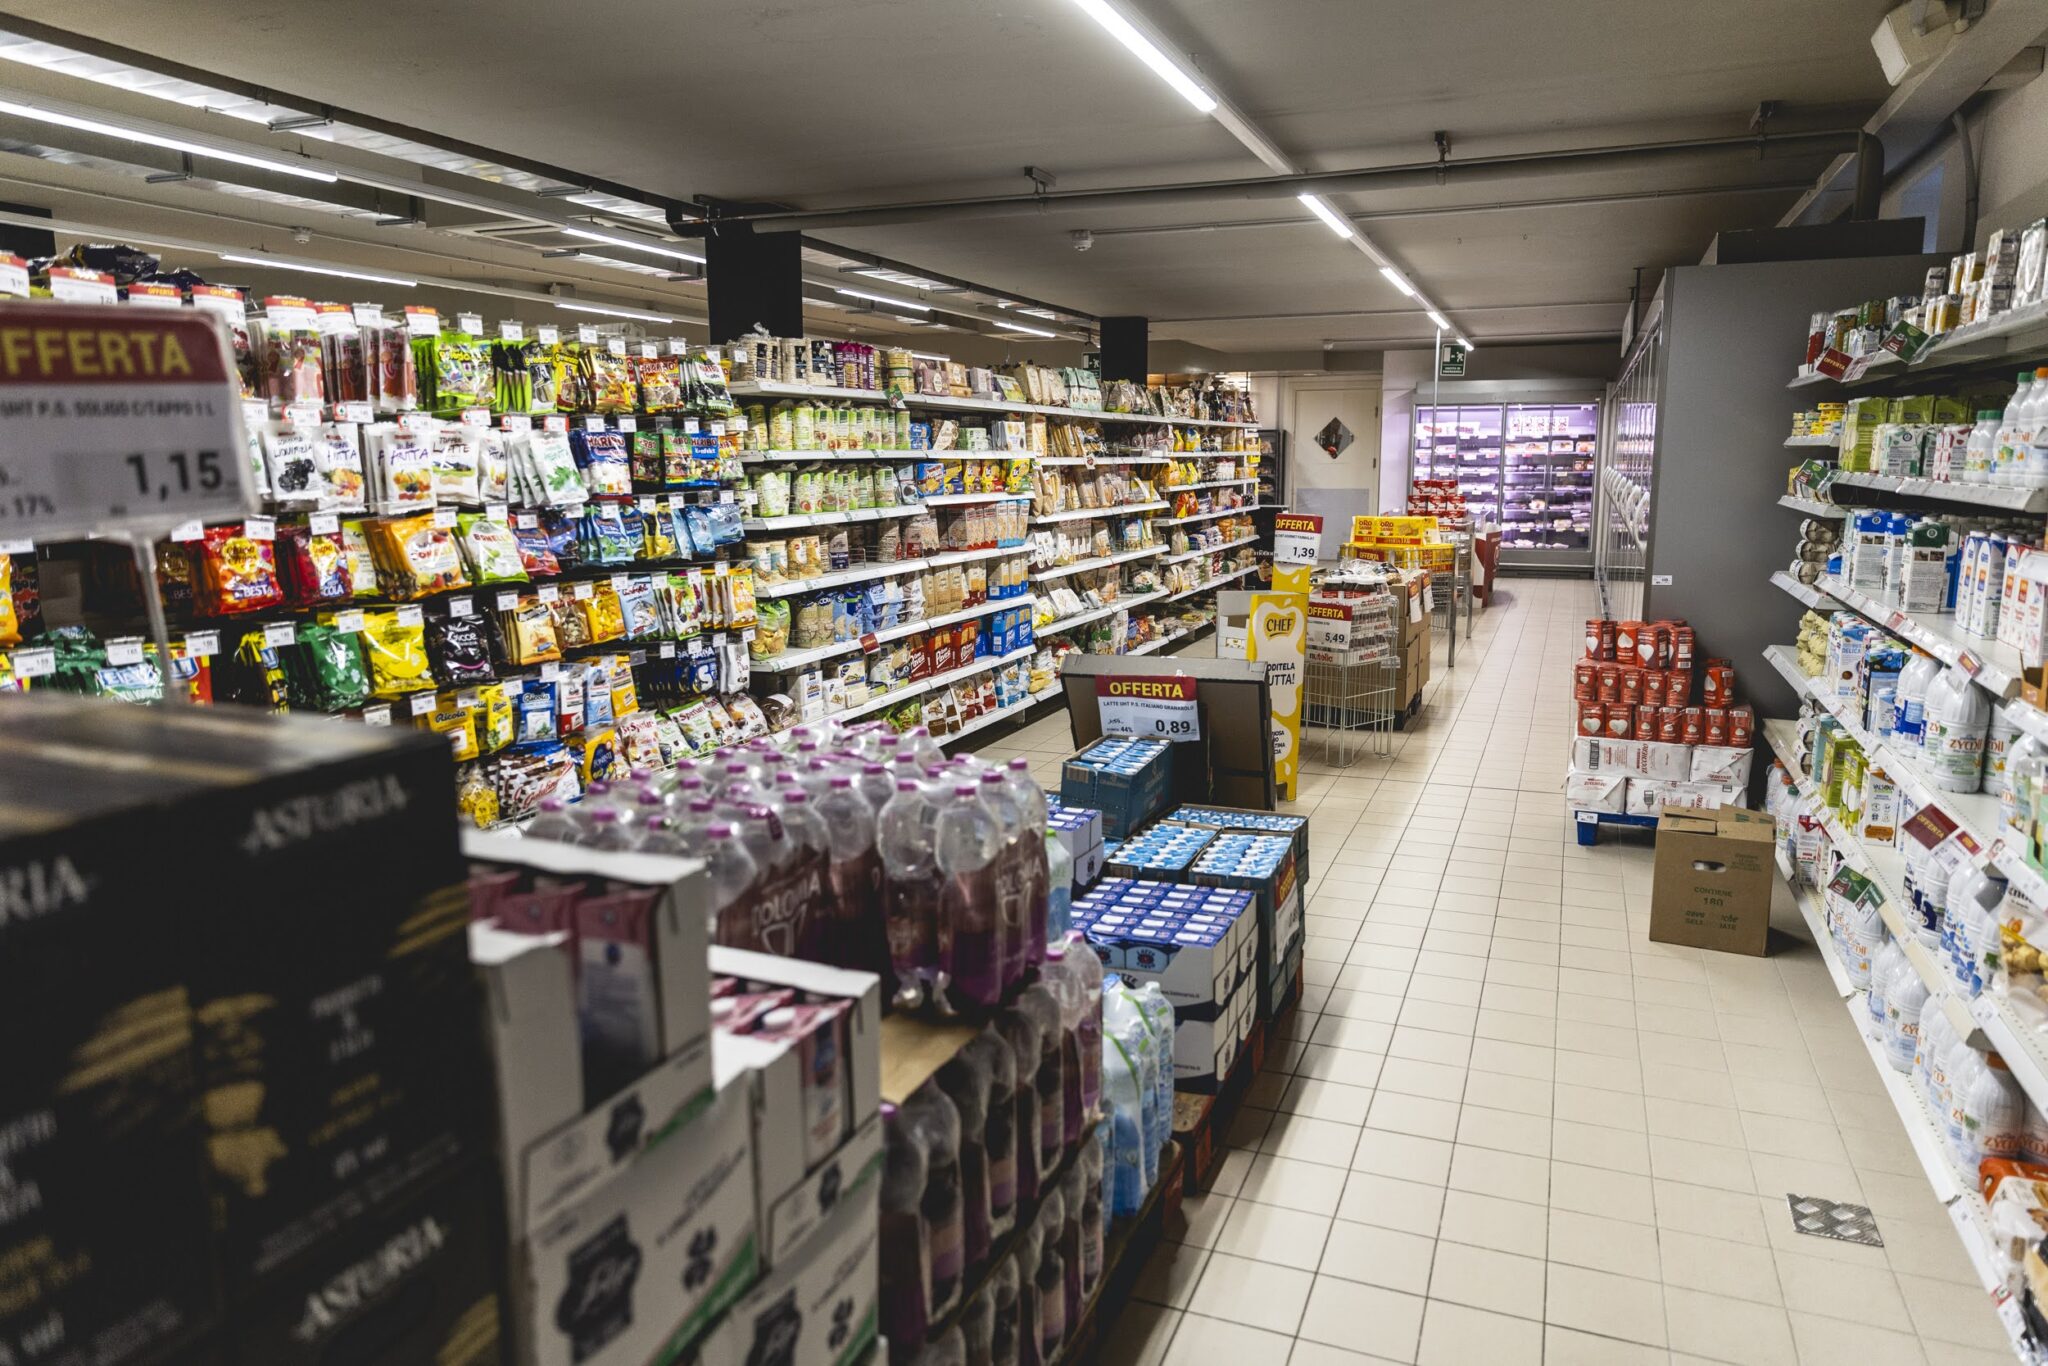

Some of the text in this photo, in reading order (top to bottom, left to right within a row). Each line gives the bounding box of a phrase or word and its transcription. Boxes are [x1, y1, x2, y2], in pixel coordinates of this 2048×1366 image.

[0, 329, 192, 376] FFERTA
[1823, 357, 1846, 371] OFFERTA
[126, 452, 223, 500] 1,15
[1276, 519, 1315, 531] OFFERTA
[1293, 547, 1315, 558] 1,39
[1308, 606, 1344, 619] OFFERTA
[1266, 618, 1293, 632] CHEF
[1325, 632, 1345, 643] 5,49
[1109, 682, 1184, 698] OFFERTA
[1155, 719, 1190, 735] 0,89
[1916, 814, 1945, 839] OFFERTA
